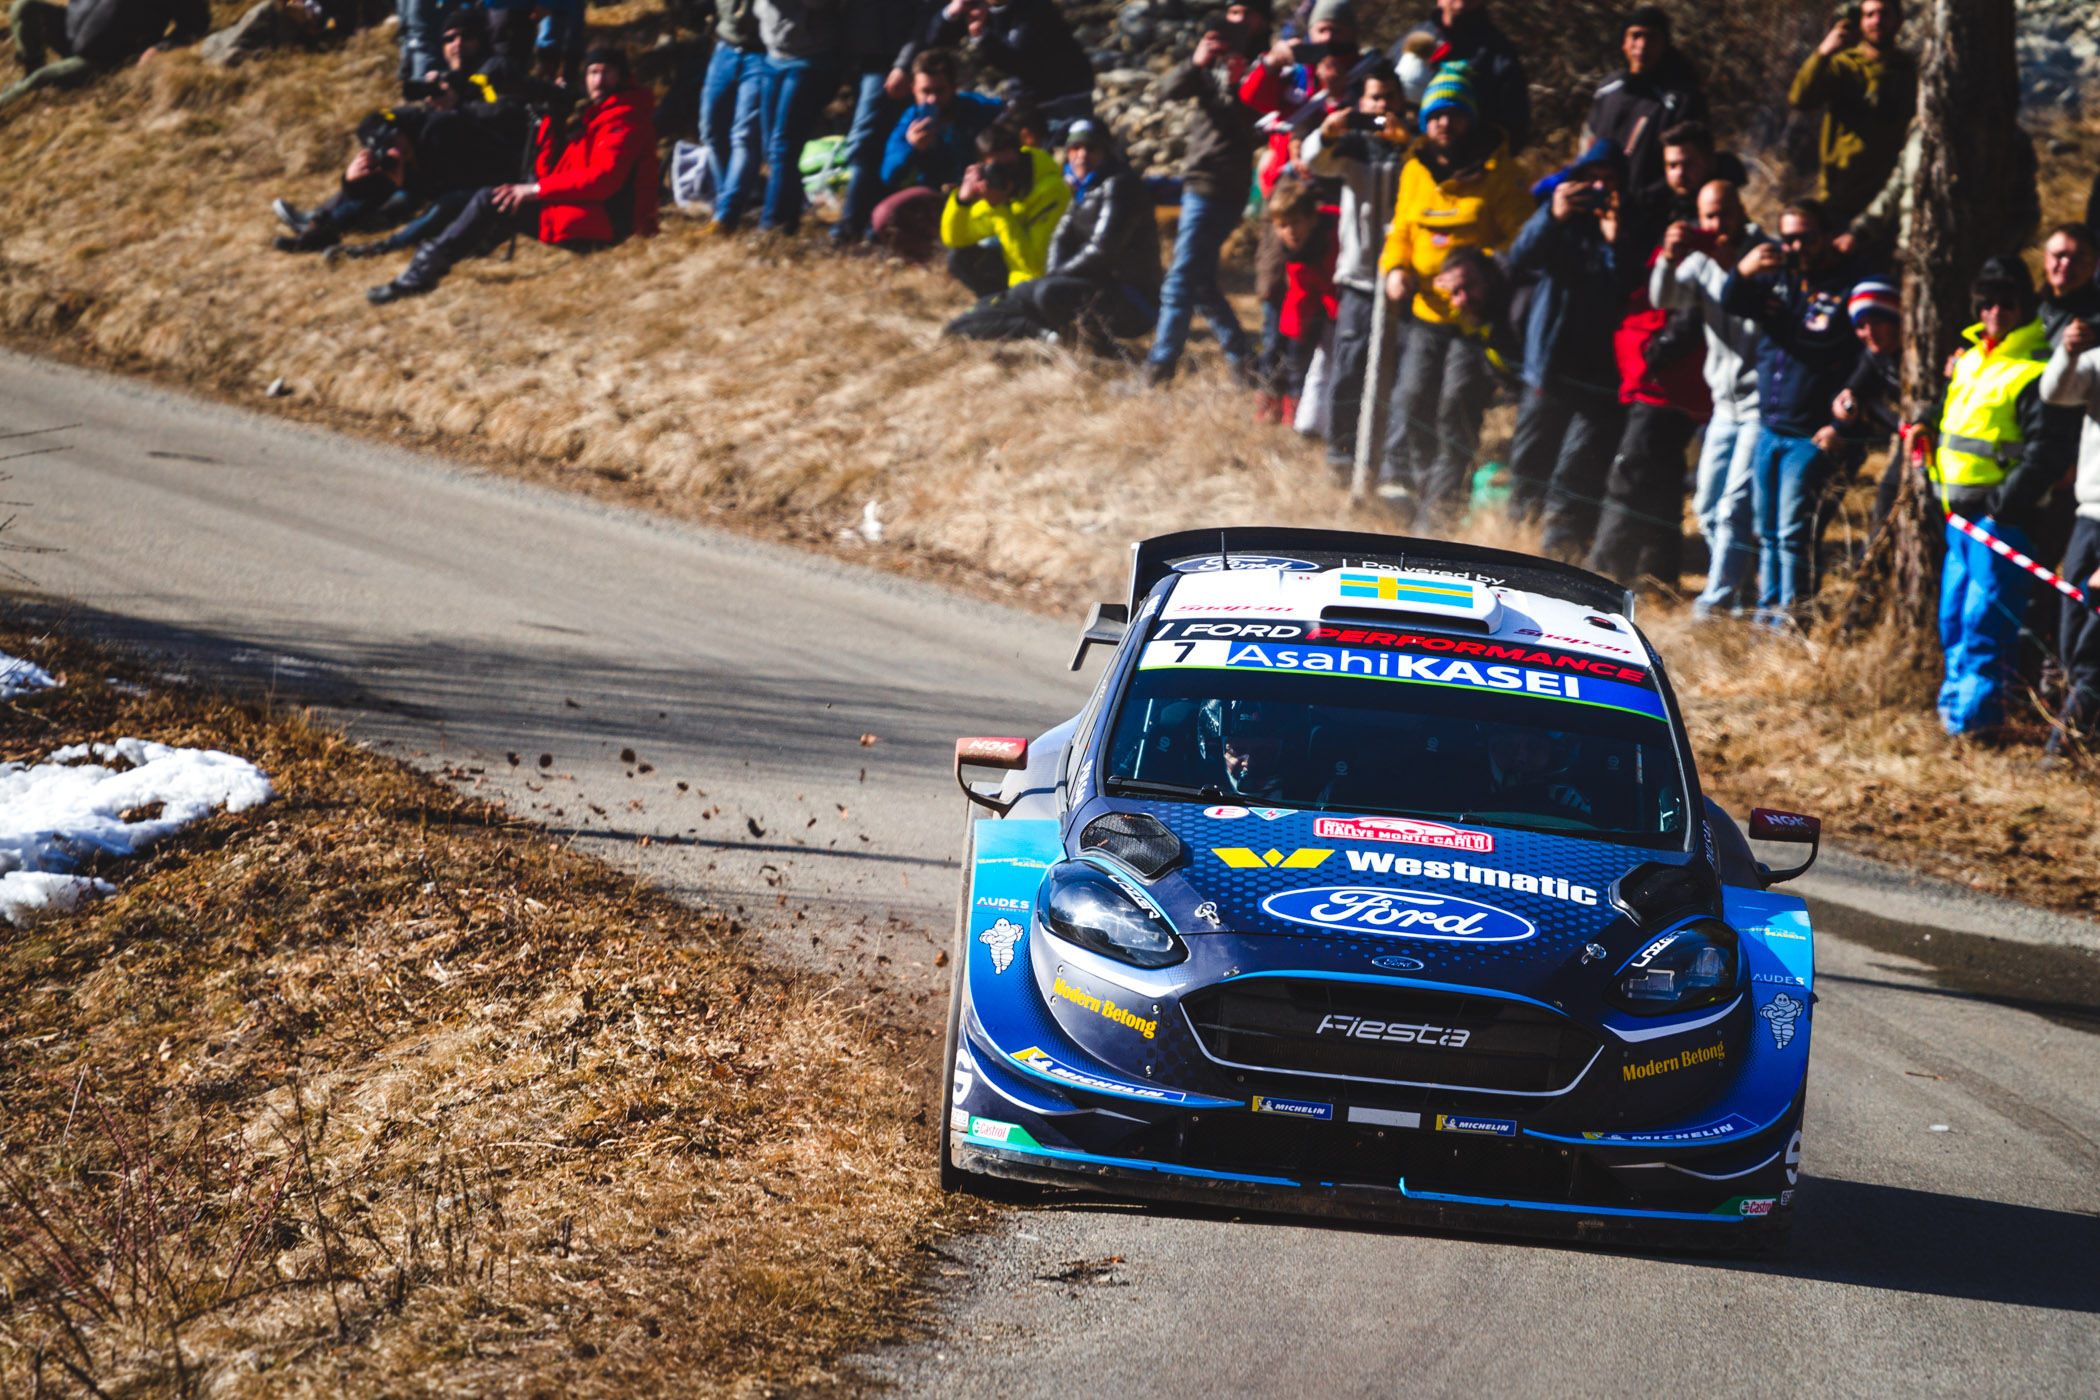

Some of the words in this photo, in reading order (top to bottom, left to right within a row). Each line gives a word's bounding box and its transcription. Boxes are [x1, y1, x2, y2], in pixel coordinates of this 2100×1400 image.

[1198, 558, 1292, 570] Ford
[1475, 573, 1506, 585] by
[1513, 628, 1631, 655] Snap-on
[1174, 642, 1197, 663] 7
[1181, 623, 1301, 638] FORD
[1305, 628, 1646, 683] PERFORMANCE
[968, 740, 1016, 752] NGK
[1764, 815, 1808, 827] NGK
[1323, 824, 1374, 838] RALLYE
[1345, 850, 1597, 905] Westmatic
[976, 896, 1030, 909] AUDES
[1108, 874, 1161, 918] LAZER
[1310, 889, 1488, 936] Ford
[1384, 958, 1412, 968] Ford
[1753, 973, 1804, 985] AUDES
[1052, 976, 1101, 1013] Modern
[1101, 1000, 1157, 1039] Betong
[1316, 1014, 1470, 1047] Fiesta
[1623, 1057, 1679, 1082] Modern
[1681, 1041, 1725, 1067] Betong
[1050, 1068, 1164, 1097] MICHELIN
[1274, 1103, 1325, 1114] MICHELIN
[980, 1122, 1007, 1138] Castrol
[1458, 1121, 1509, 1132] MICHELIN
[1631, 1123, 1734, 1140] MICHELIN
